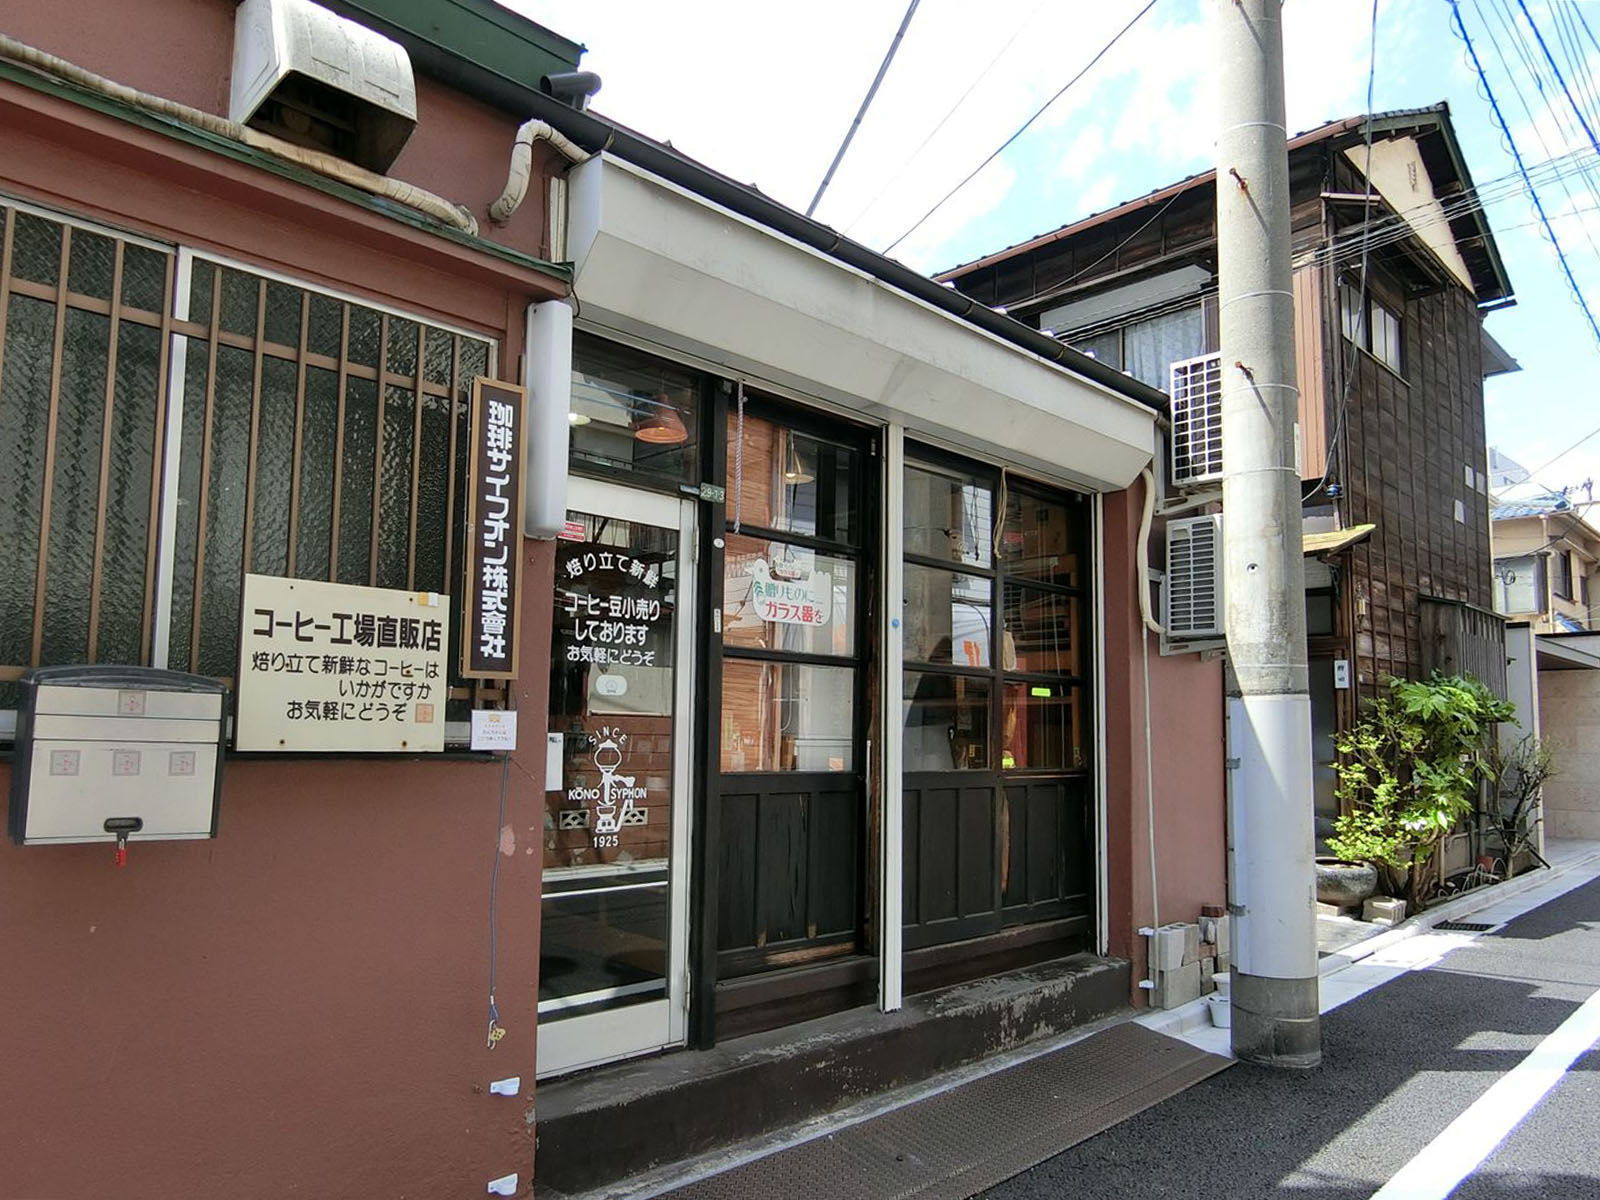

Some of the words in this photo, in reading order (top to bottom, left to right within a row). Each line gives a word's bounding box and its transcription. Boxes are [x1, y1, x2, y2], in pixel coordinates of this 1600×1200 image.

[565, 551, 660, 589] 焙り立て新鮮
[565, 592, 661, 622] コーヒー豆小売り
[766, 601, 824, 623] ガラス器を
[253, 608, 442, 652] コーヒー工場直販店
[574, 618, 649, 646] しております
[251, 651, 440, 679] 焙り立て新鮮なコーヒーは
[567, 645, 656, 666] お気軽にどうぞ
[338, 679, 433, 701] いかがですか
[286, 699, 408, 722] お気軽にどうぞ
[588, 726, 628, 745] SINCE
[610, 787, 648, 800] SYPHON
[593, 835, 619, 849] 1925
